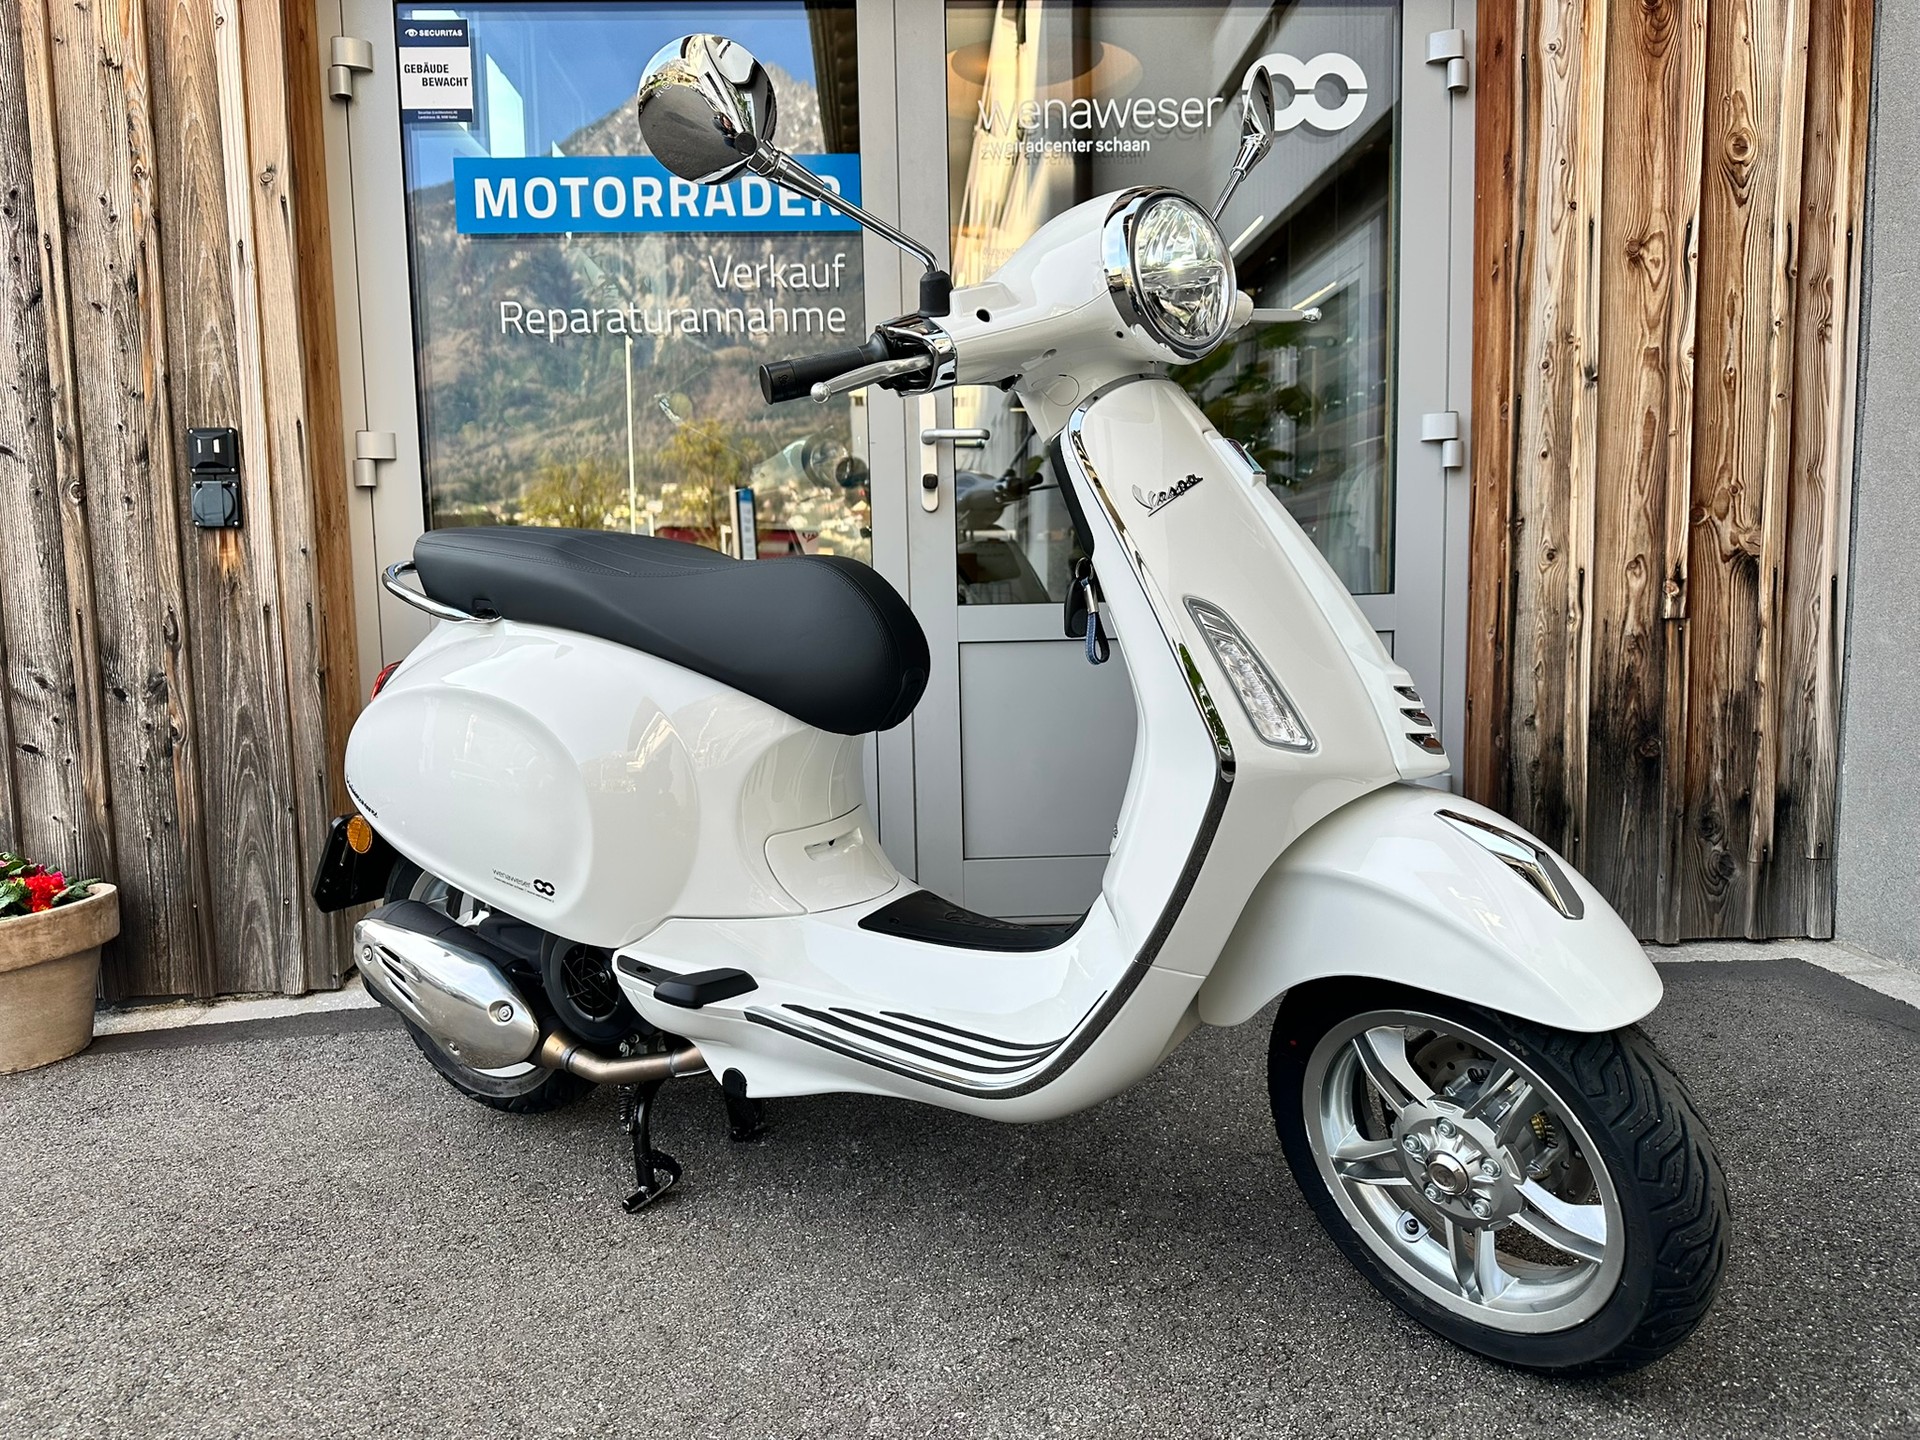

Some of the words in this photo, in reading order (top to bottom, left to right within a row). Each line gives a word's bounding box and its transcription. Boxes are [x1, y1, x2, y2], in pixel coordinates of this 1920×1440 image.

[419, 29, 463, 37] SECURITAS
[404, 62, 449, 74] GEBÄUDE
[422, 77, 468, 87] BEWACHT
[977, 96, 1224, 131] wenaweser
[1095, 137, 1151, 153] schaan
[708, 252, 846, 290] Verkauf
[499, 298, 847, 344] Reparaturannahme
[1131, 473, 1204, 518] Vespa
